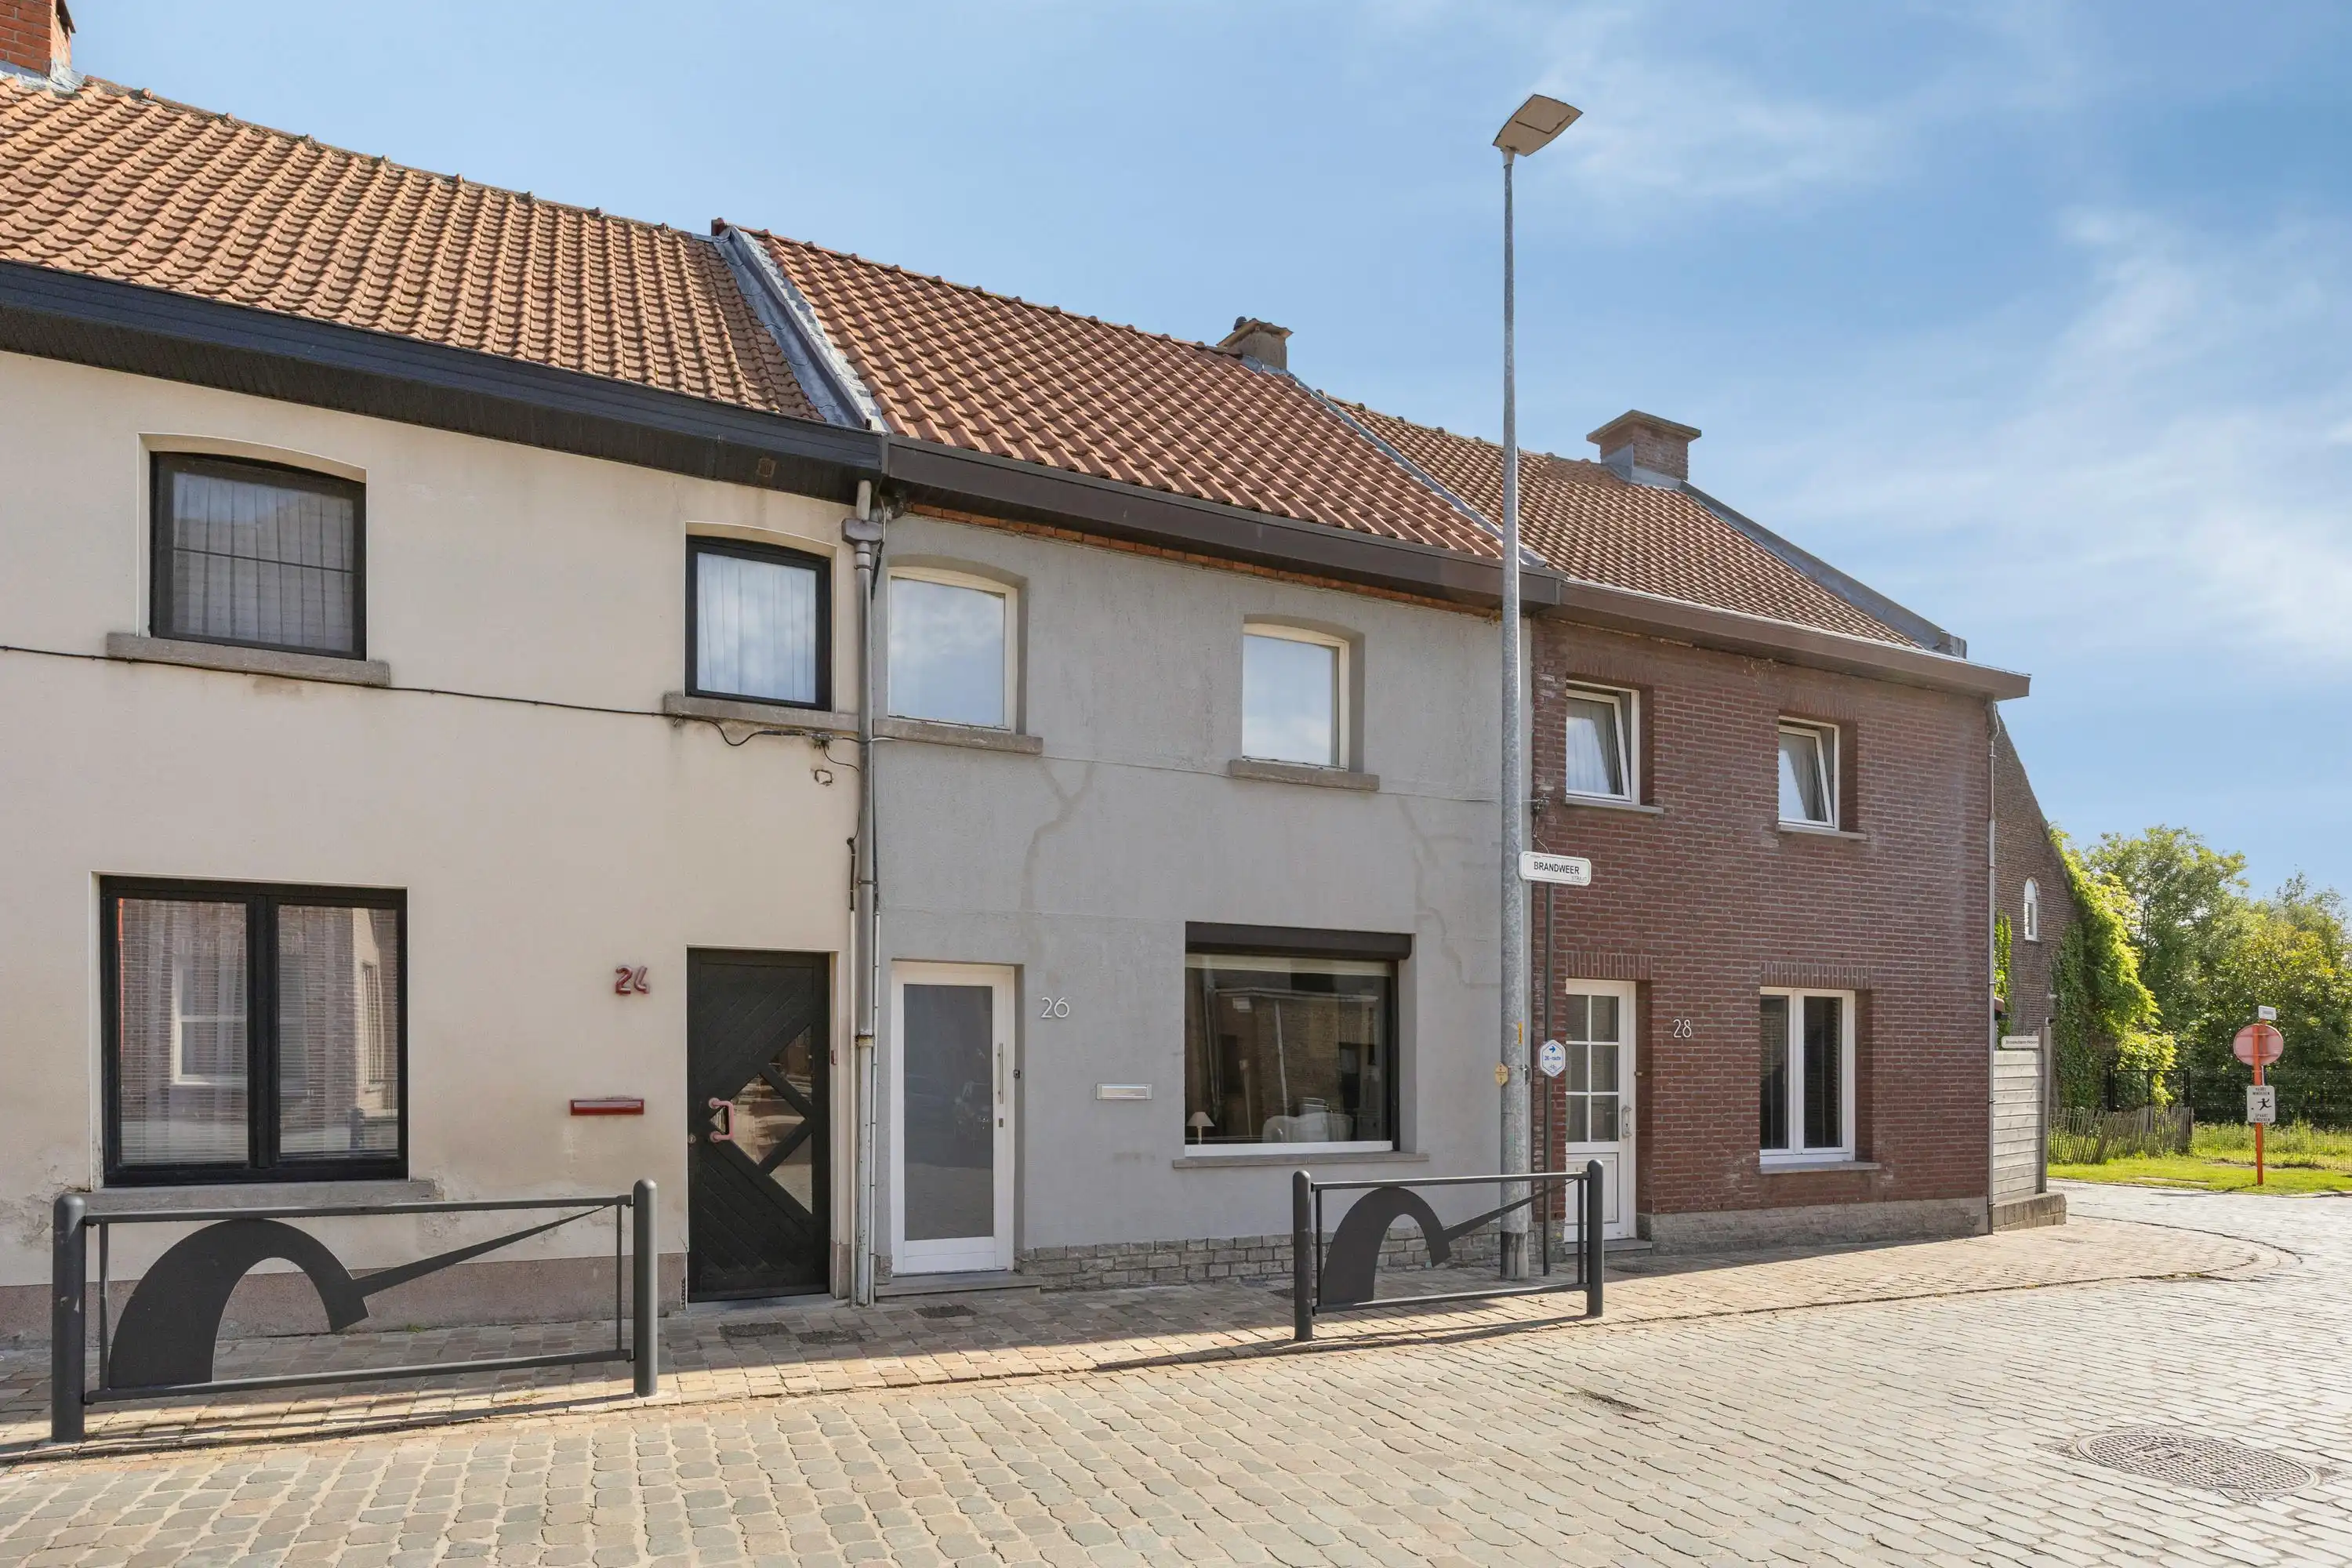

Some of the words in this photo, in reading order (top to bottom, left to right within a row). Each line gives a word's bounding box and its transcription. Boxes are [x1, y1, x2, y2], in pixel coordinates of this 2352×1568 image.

[1534, 861, 1580, 875] BRANDWEER
[1040, 996, 1070, 1018] 26
[1672, 1018, 1693, 1039] 28
